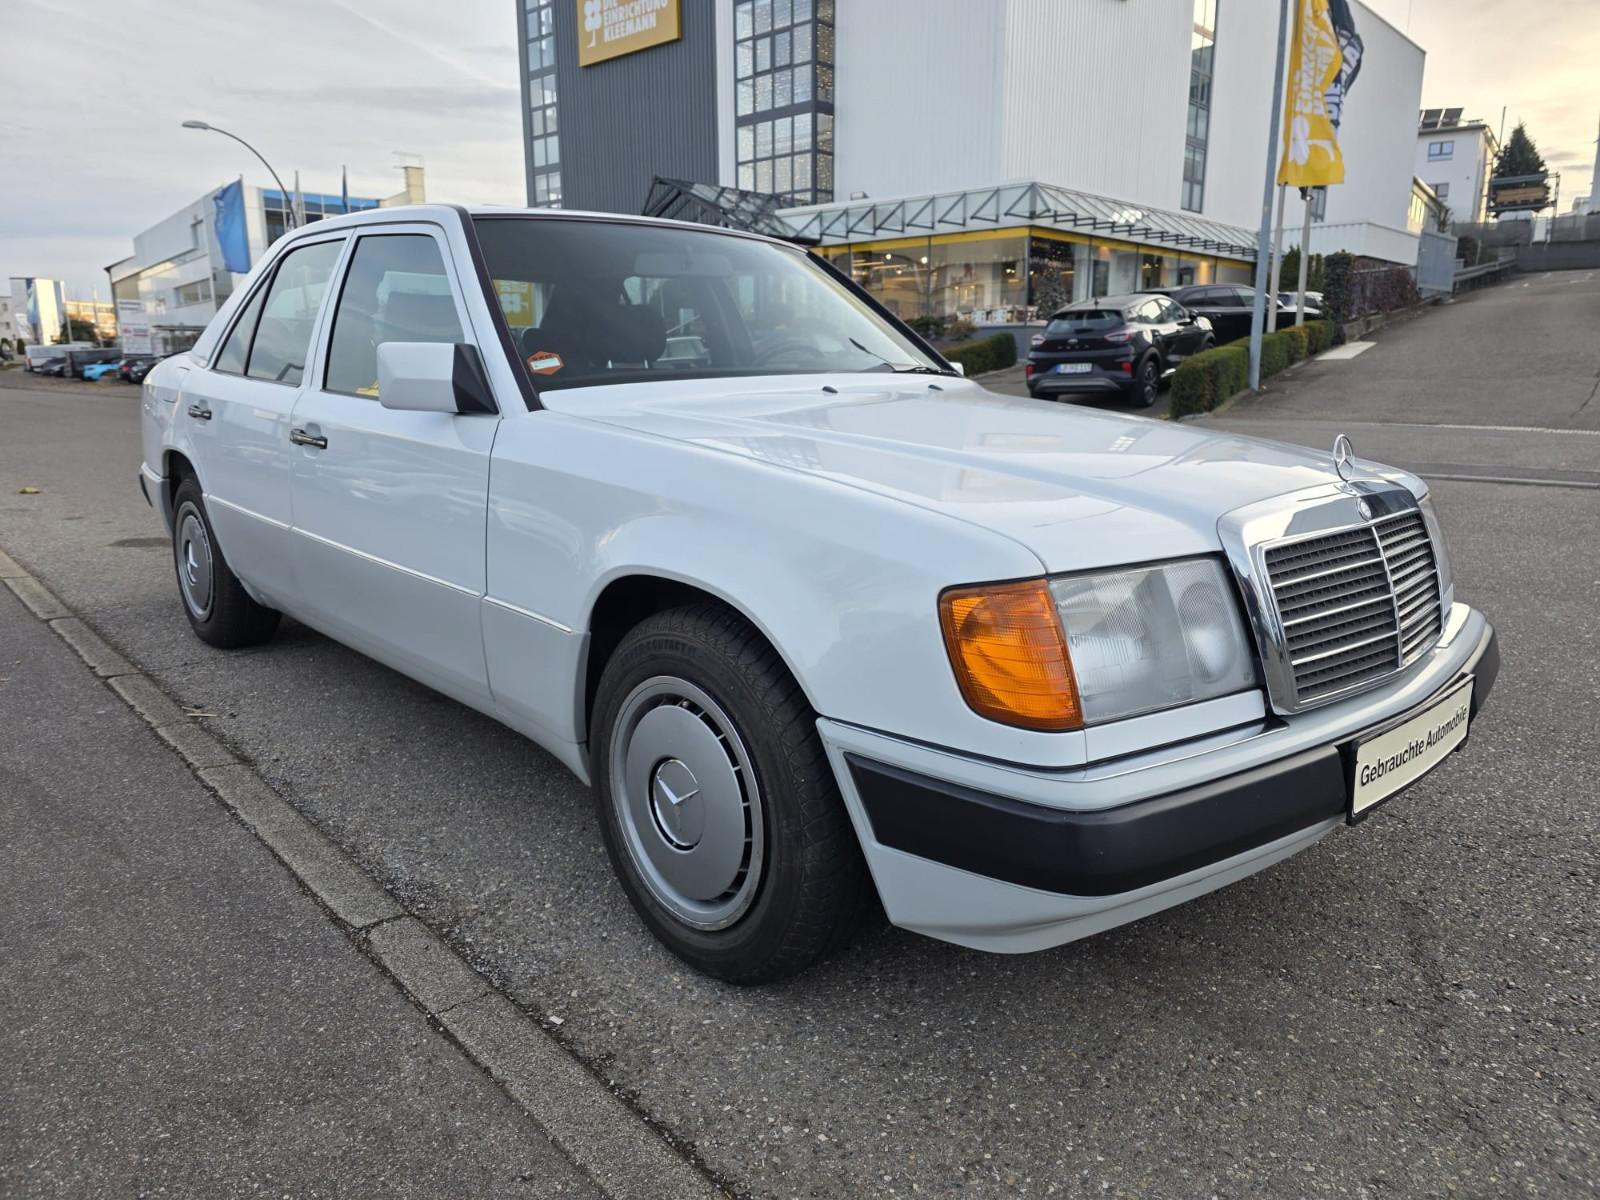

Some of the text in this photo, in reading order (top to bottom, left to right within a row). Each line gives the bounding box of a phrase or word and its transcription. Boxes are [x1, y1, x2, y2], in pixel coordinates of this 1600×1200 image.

[603, 13, 657, 43] KLEEMANN
[1360, 705, 1467, 786] Gebrauchte Automobile
